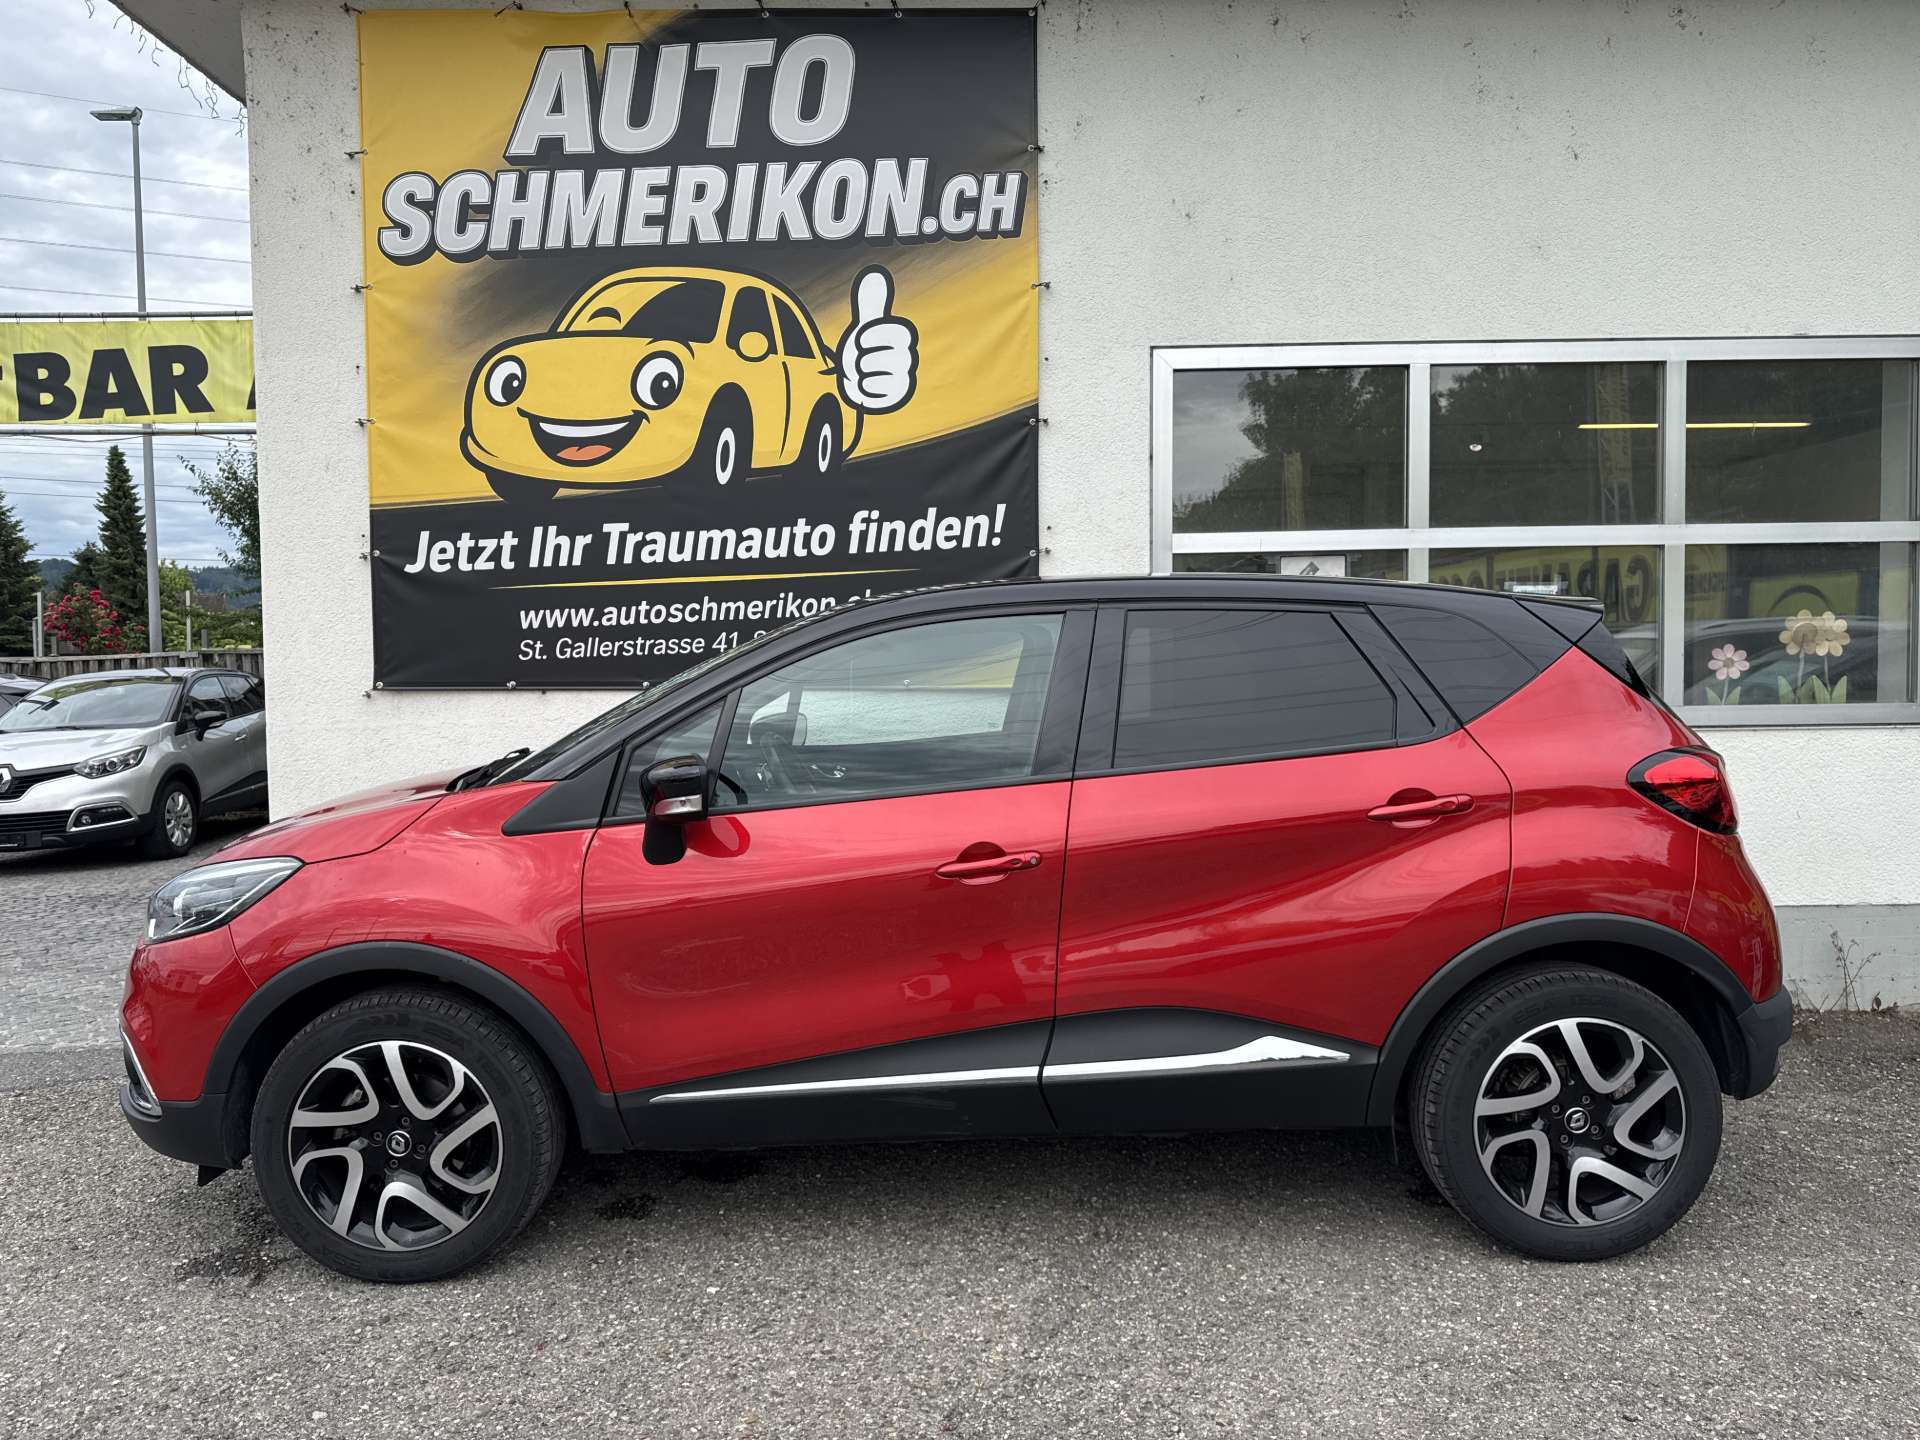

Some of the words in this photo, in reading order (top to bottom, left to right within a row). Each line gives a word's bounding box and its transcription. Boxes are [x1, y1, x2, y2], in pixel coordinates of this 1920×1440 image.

[504, 32, 857, 158] AUTO
[379, 157, 1022, 258] SCHMERIKON.CH
[0, 344, 216, 422] BAR
[404, 530, 518, 575] Jetzt
[528, 525, 590, 568] Ihr
[602, 517, 836, 565] Traumauto
[848, 503, 1006, 555] finden!
[518, 639, 548, 661] St.
[555, 634, 706, 659] Gallerstrasse
